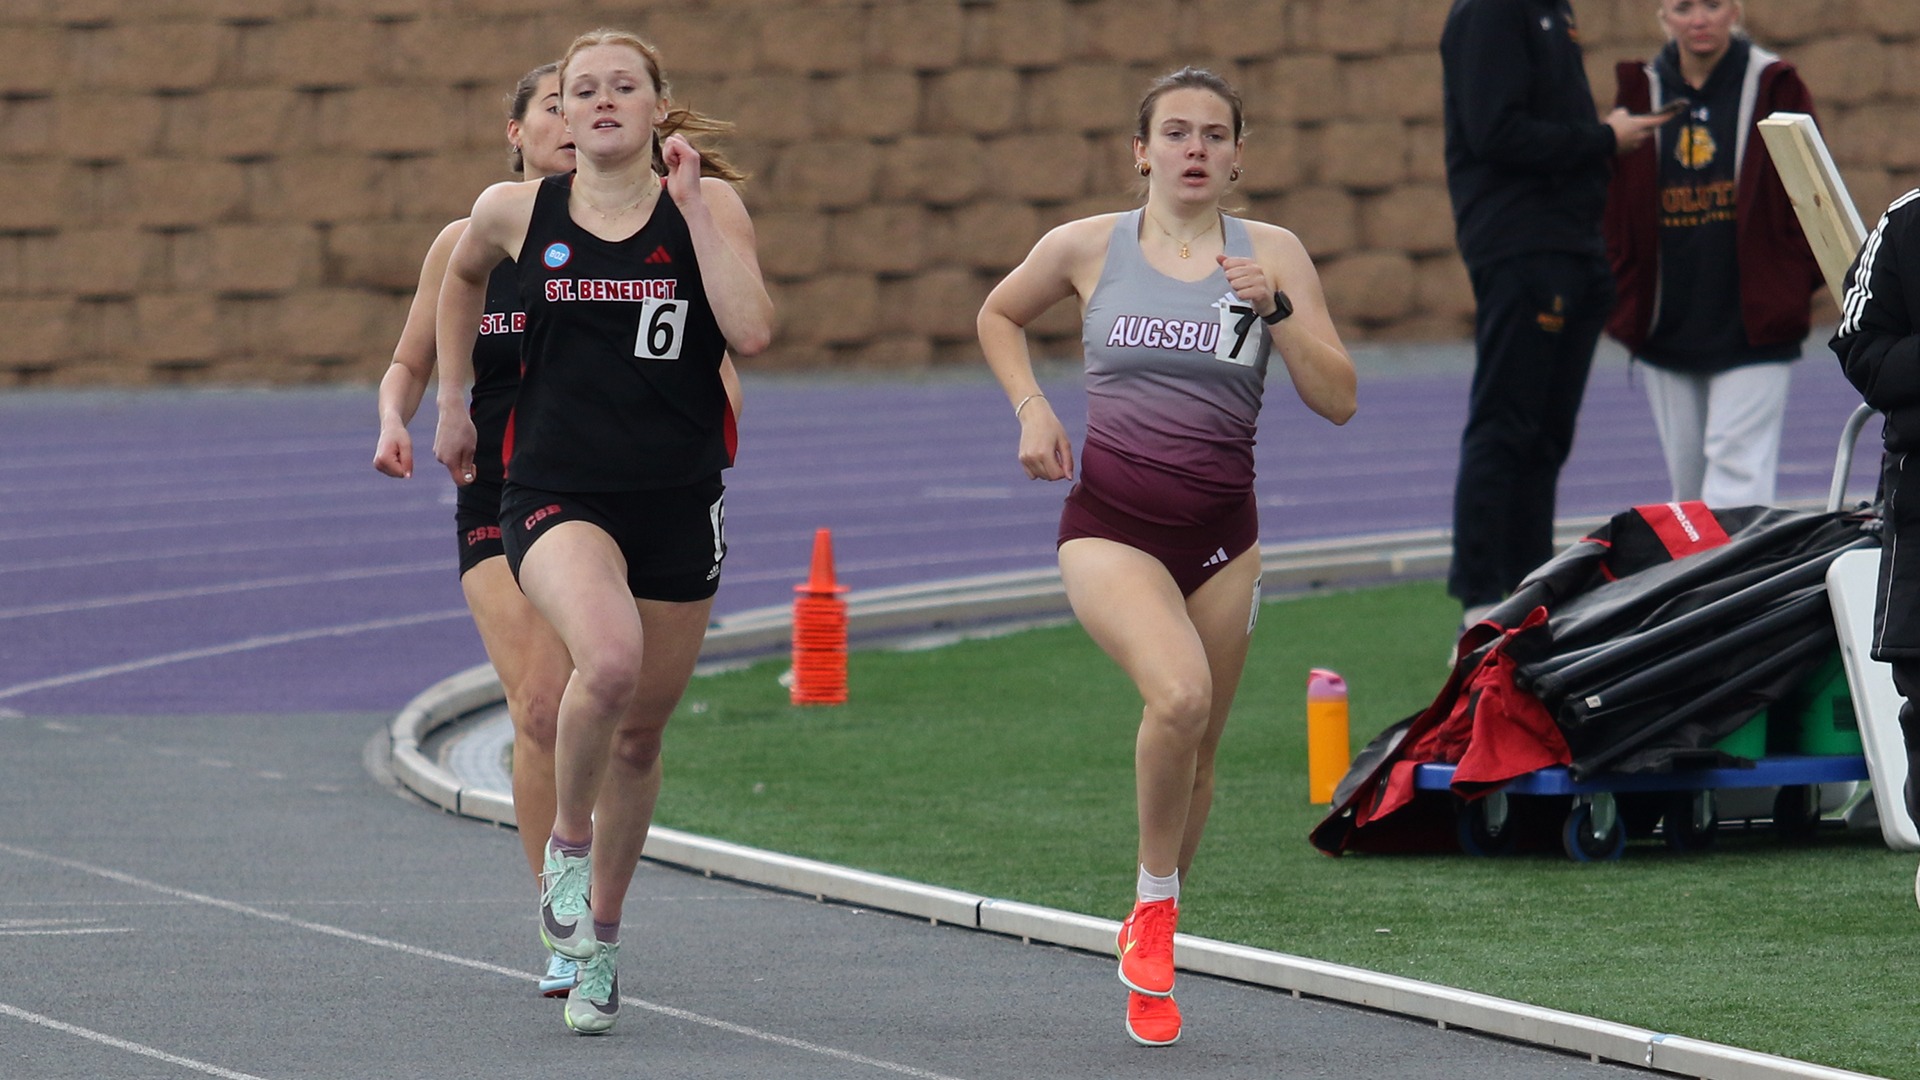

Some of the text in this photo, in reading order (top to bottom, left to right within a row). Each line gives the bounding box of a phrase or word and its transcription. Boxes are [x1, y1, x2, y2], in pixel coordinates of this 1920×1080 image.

[545, 279, 677, 302] ST. BENEDICT
[480, 312, 509, 336] ST.
[647, 303, 677, 356] 6
[1107, 314, 1220, 354] AUGSBU
[1229, 305, 1259, 359] 7
[525, 504, 562, 531] CSB
